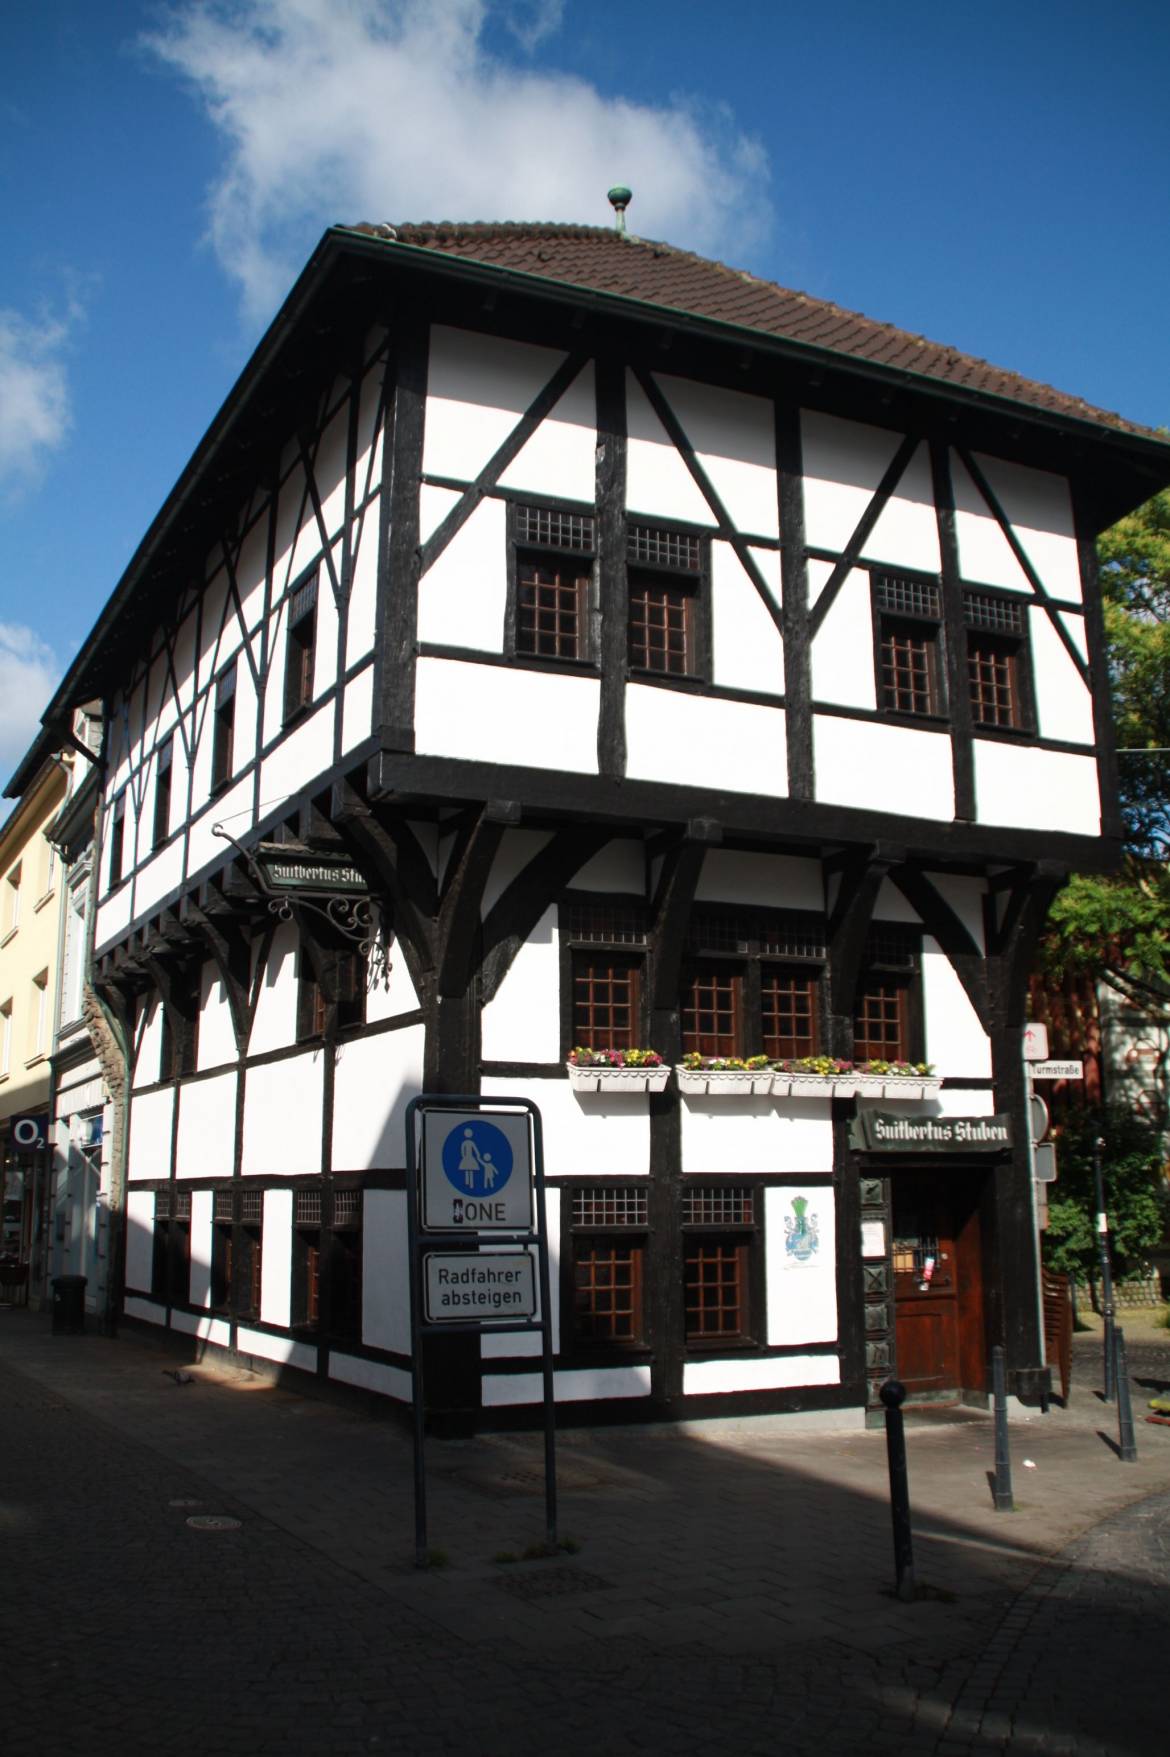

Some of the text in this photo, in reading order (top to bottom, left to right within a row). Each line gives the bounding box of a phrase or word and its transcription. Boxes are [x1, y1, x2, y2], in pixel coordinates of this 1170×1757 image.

[274, 864, 366, 884] Suitbertus Stu
[876, 1119, 1008, 1141] Suitbertus Stuben
[453, 1199, 506, 1224] ONE
[439, 1268, 522, 1285] Radfahrer
[441, 1289, 522, 1307] absteigen
